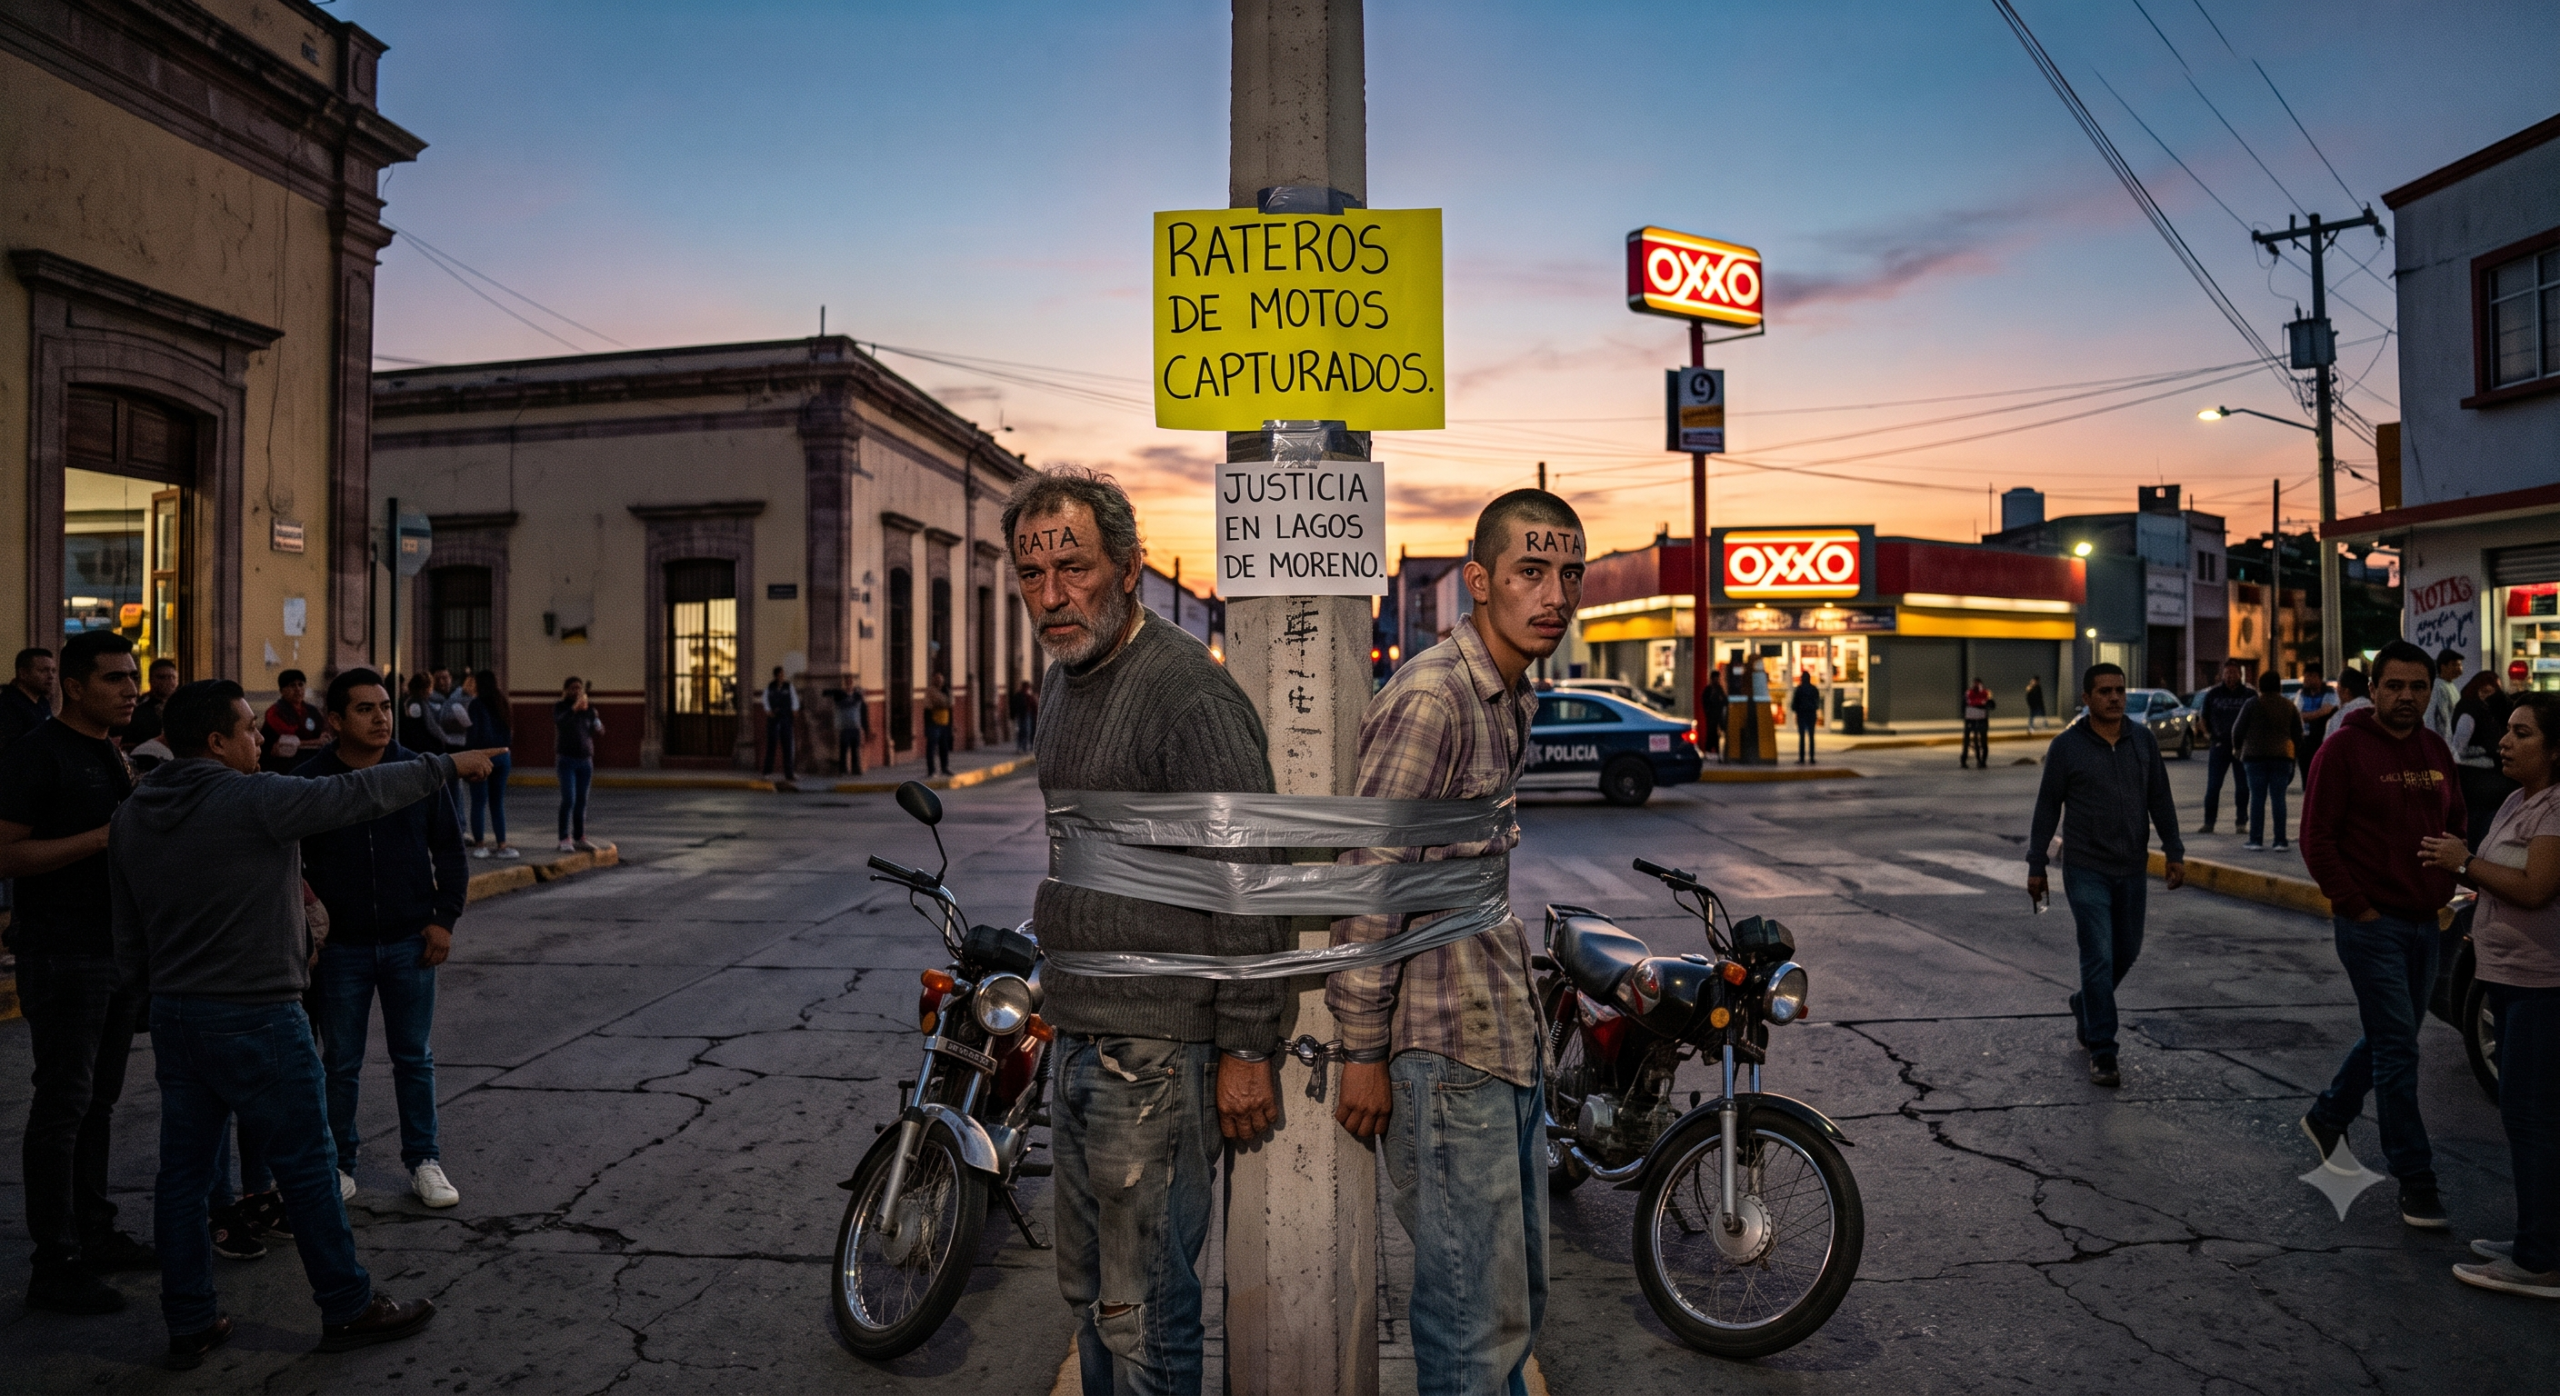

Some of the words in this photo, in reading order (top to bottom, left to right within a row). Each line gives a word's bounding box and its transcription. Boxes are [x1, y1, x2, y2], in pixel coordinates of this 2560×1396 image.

[1167, 220, 1389, 277] RATEROS
[1647, 247, 1760, 306] OXXO
[1168, 293, 1222, 334] DE
[1250, 287, 1389, 330] MOTOS
[1163, 349, 1435, 400] CAPTURADOS.
[1223, 472, 1368, 504] JUSTICIA
[1018, 526, 1080, 557] RATA
[1225, 515, 1261, 541] EN
[1276, 513, 1364, 540] LAGOS
[1525, 531, 1583, 555] RATA
[1223, 554, 1256, 579] DE
[1269, 551, 1385, 580] MORENO.
[1728, 544, 1856, 586] OXXO
[1545, 744, 1600, 762] POLICIA
